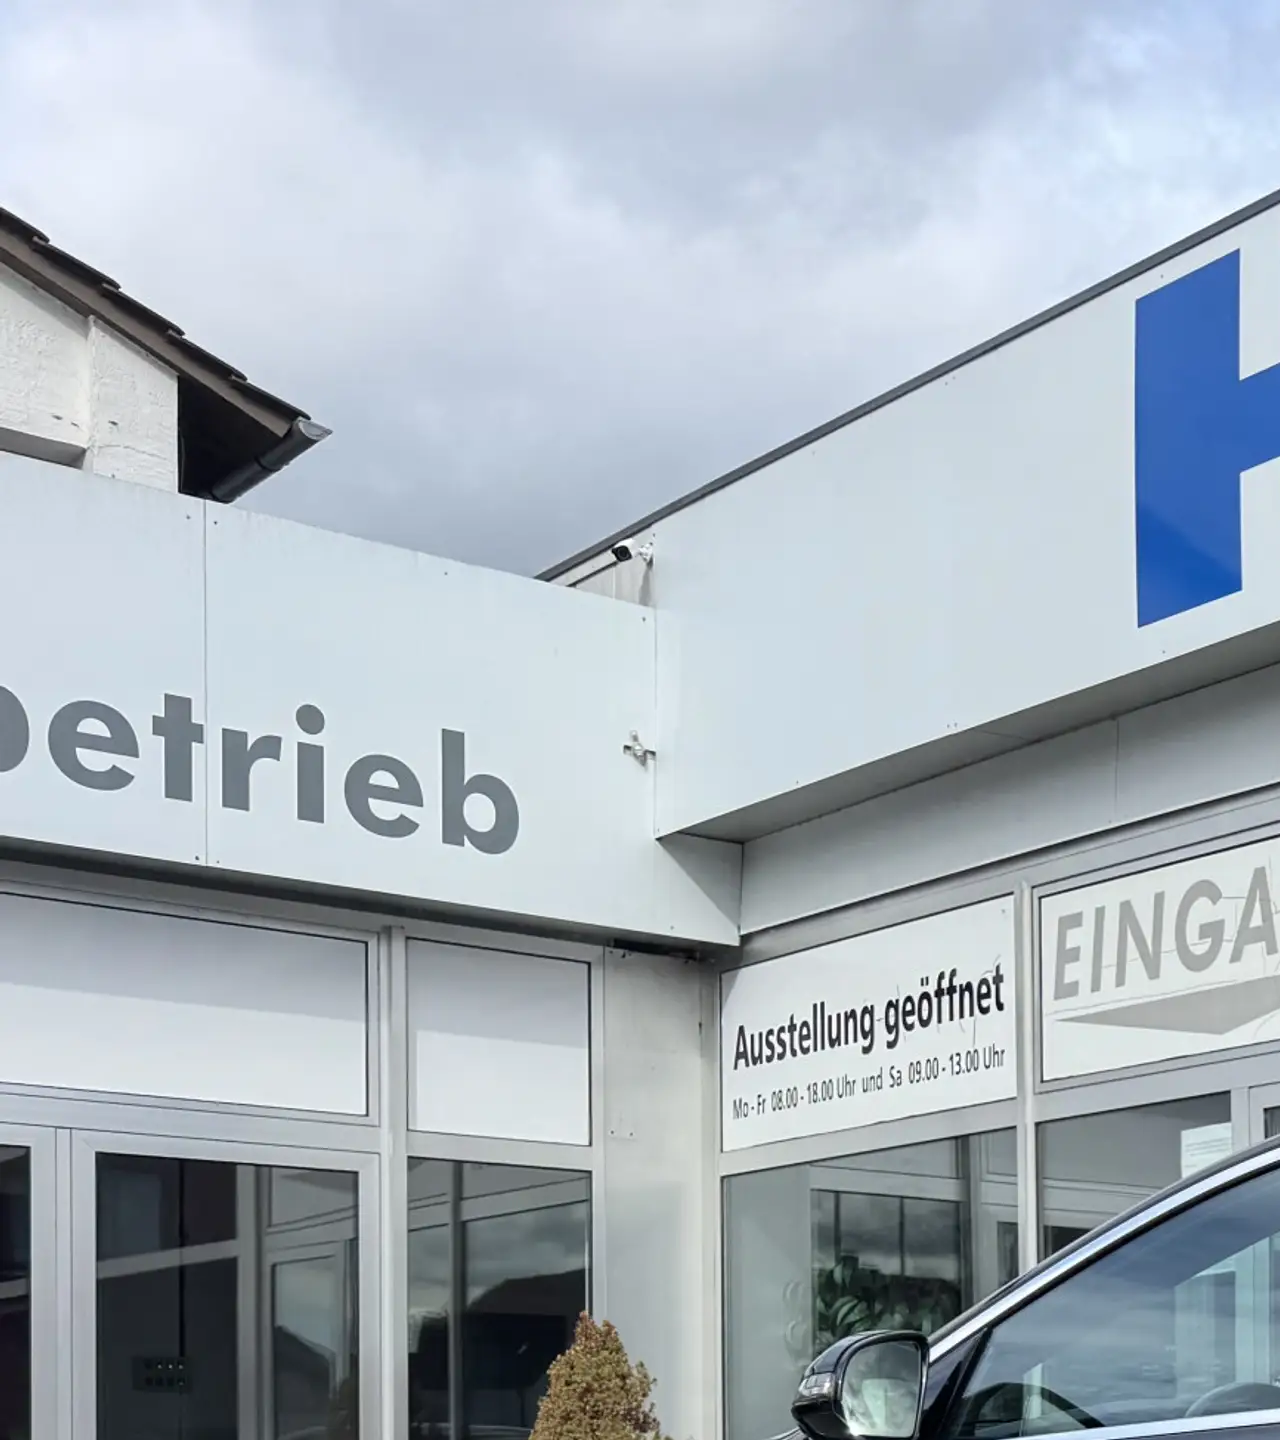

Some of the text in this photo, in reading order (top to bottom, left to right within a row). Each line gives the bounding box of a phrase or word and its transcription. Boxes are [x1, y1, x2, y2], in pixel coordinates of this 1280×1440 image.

[733, 963, 1005, 1070] Ausstellung geöffnet
[771, 1087, 799, 1112] 08.00
[807, 1078, 834, 1105] 18.00
[837, 1074, 856, 1099] Uhr
[862, 1067, 883, 1093] und
[889, 1065, 902, 1088] Sa
[908, 1057, 939, 1084] 09.00
[950, 1048, 979, 1076] 13.00
[983, 1043, 1006, 1070] Uhr
